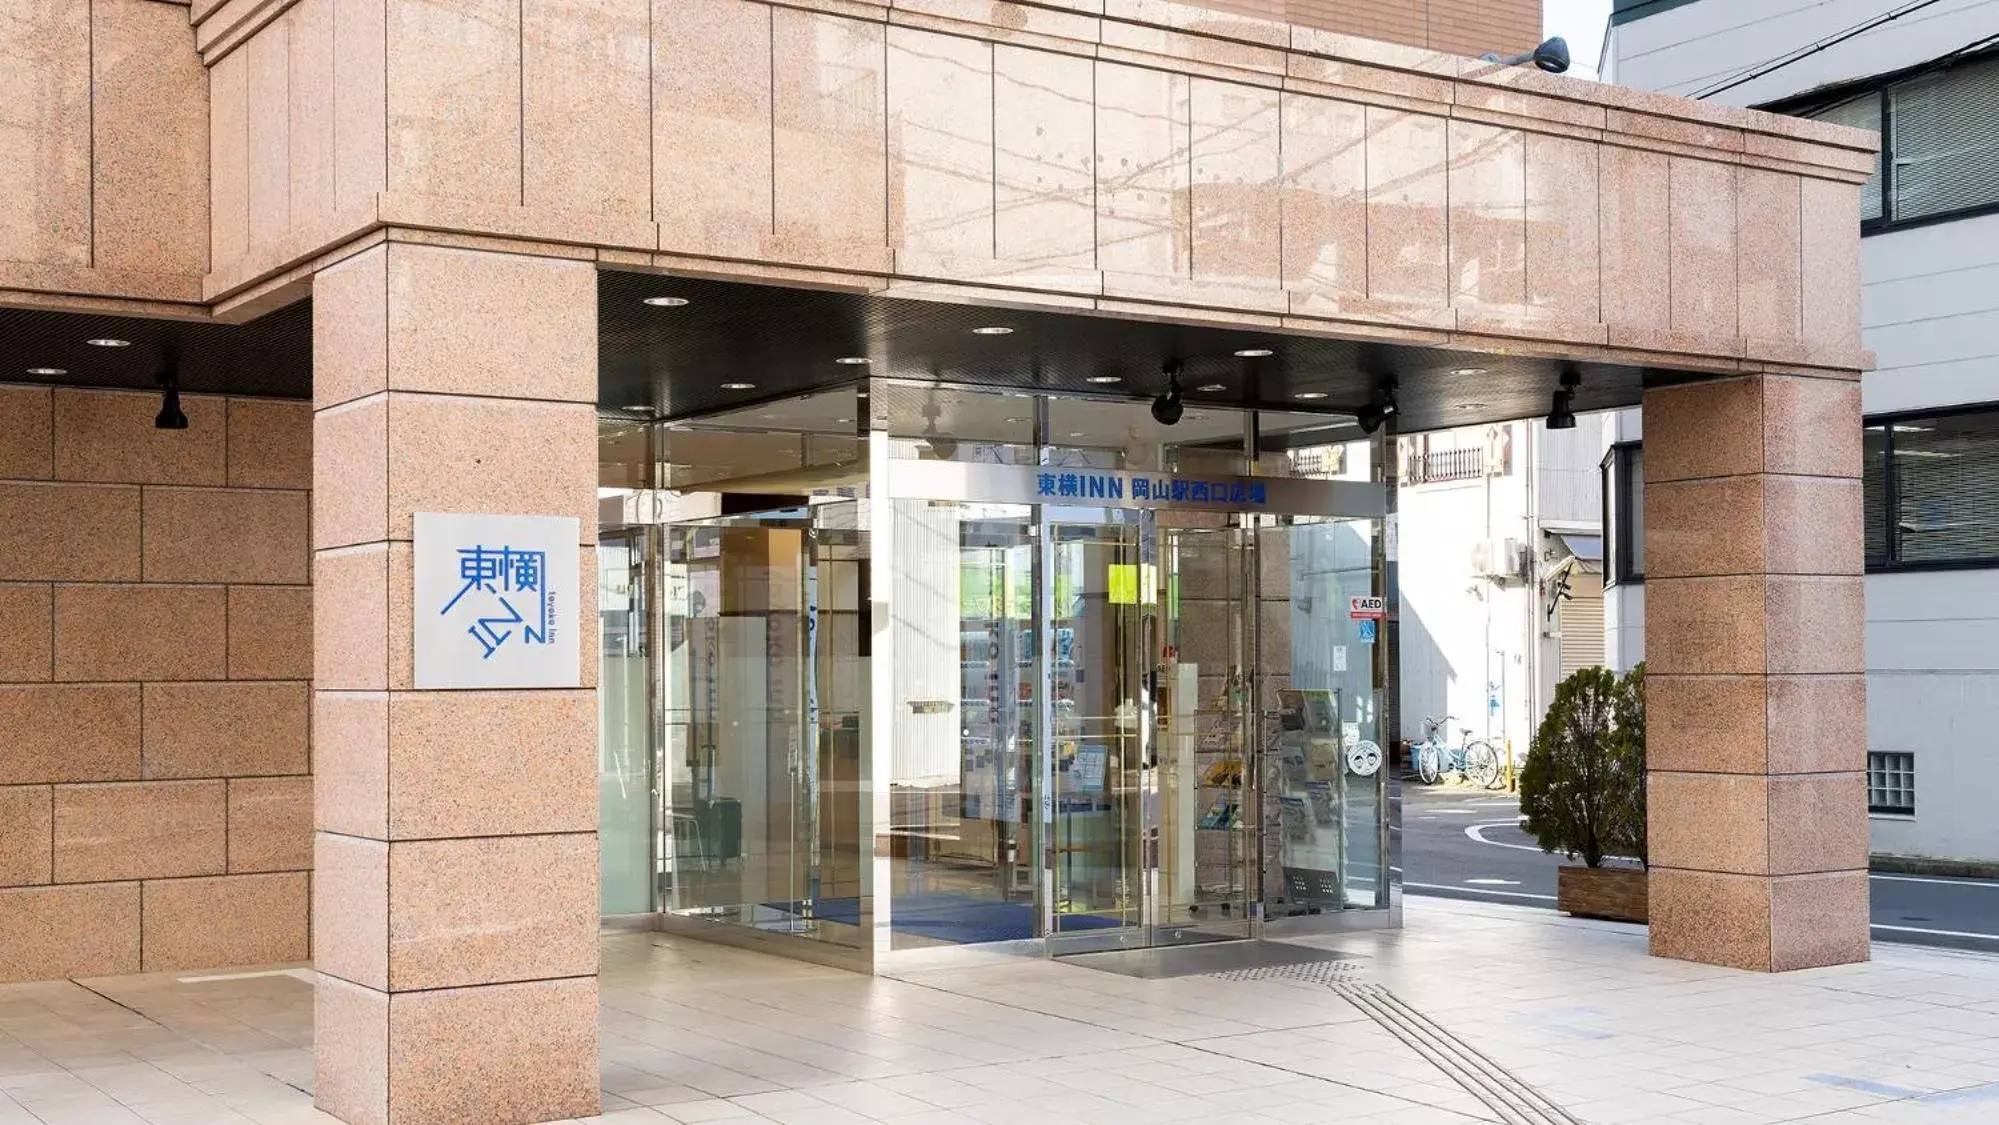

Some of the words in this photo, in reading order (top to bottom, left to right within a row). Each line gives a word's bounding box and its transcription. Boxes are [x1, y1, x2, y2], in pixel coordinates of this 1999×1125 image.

[1132, 478, 1267, 504] 岡山駅西口広場
[1361, 599, 1382, 609] AED
